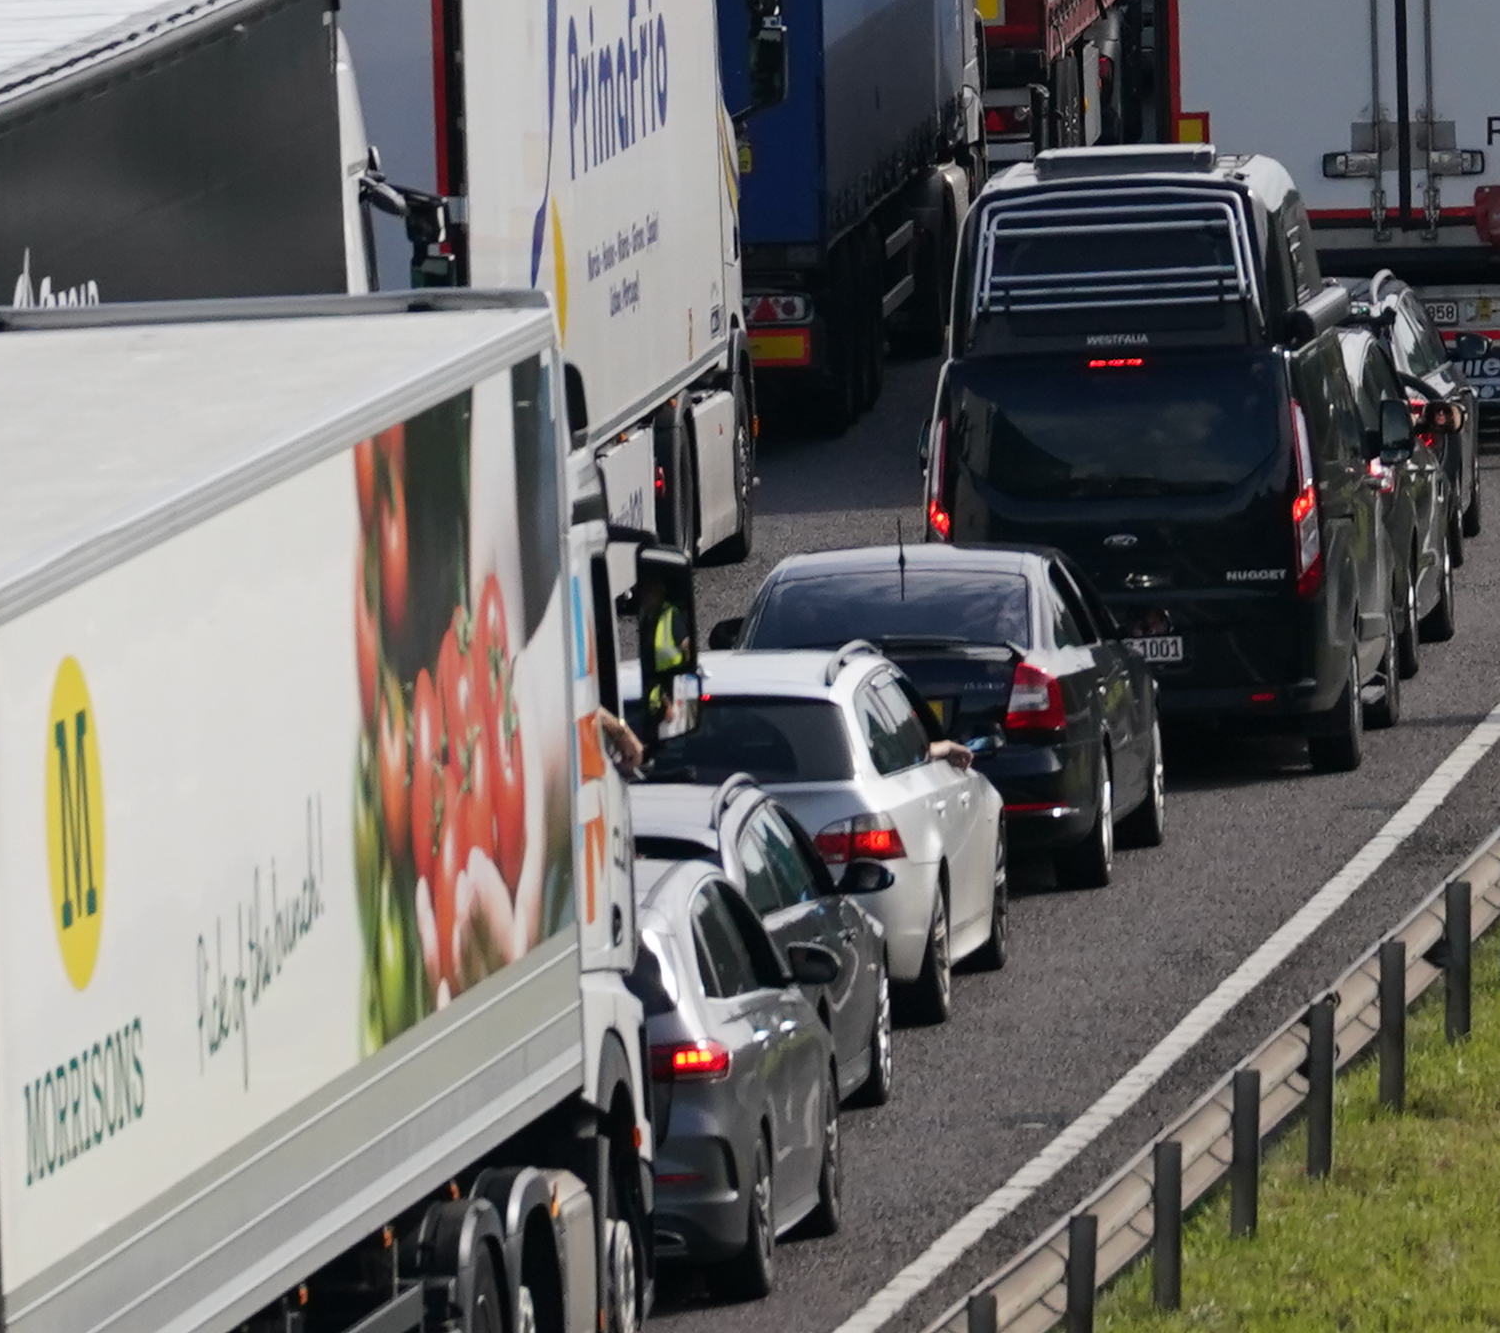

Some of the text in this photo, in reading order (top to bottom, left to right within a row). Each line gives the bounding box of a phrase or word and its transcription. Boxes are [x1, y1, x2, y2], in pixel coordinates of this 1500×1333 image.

[1086, 333, 1148, 345] WESTFALIA
[55, 709, 97, 929] M
[23, 1016, 145, 1186] MORRISONS
